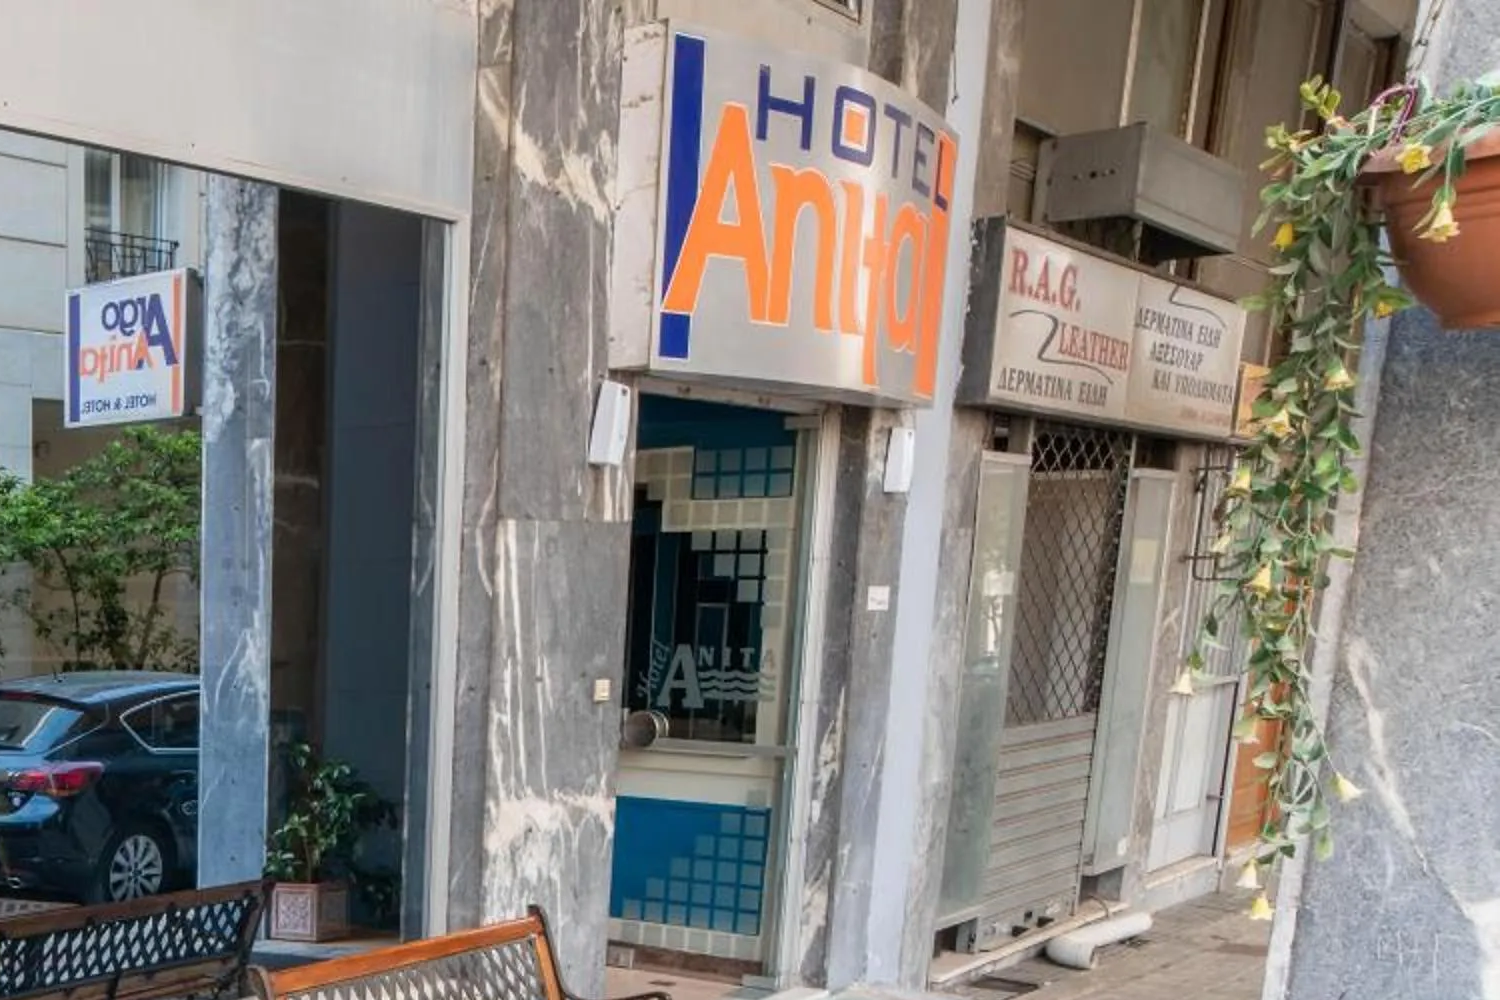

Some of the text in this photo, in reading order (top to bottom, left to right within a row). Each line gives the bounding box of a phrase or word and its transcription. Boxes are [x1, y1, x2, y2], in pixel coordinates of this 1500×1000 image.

[755, 62, 960, 212] HOTEL
[1008, 248, 1082, 311] R.A.G.
[1057, 320, 1131, 373] LEATHER
[997, 366, 1108, 407] ΔΕΡΜΑΤΙΝΑ ΕΙΔΗ
